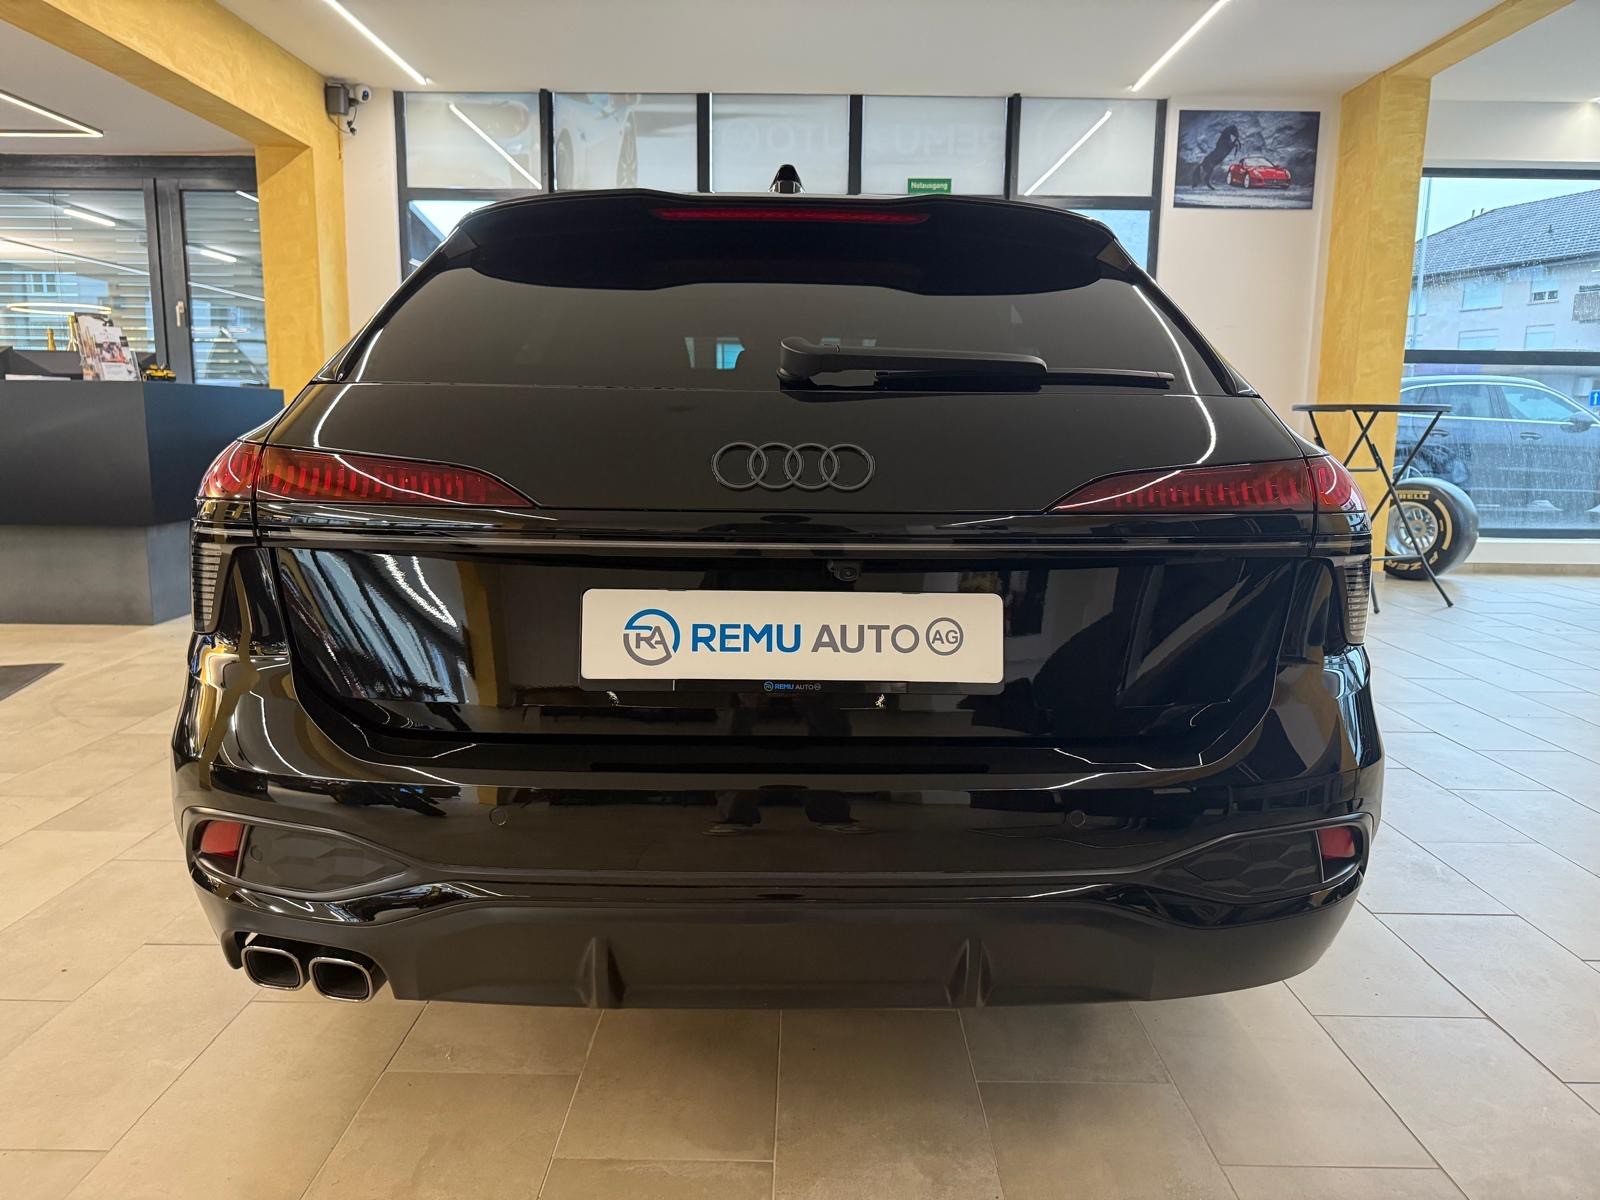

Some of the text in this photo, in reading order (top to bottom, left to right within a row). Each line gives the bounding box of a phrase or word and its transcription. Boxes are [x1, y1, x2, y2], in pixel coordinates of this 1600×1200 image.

[911, 181, 948, 191] Notausgang
[691, 623, 801, 653] REMU
[811, 624, 920, 654] AUTO
[931, 629, 960, 645] AG
